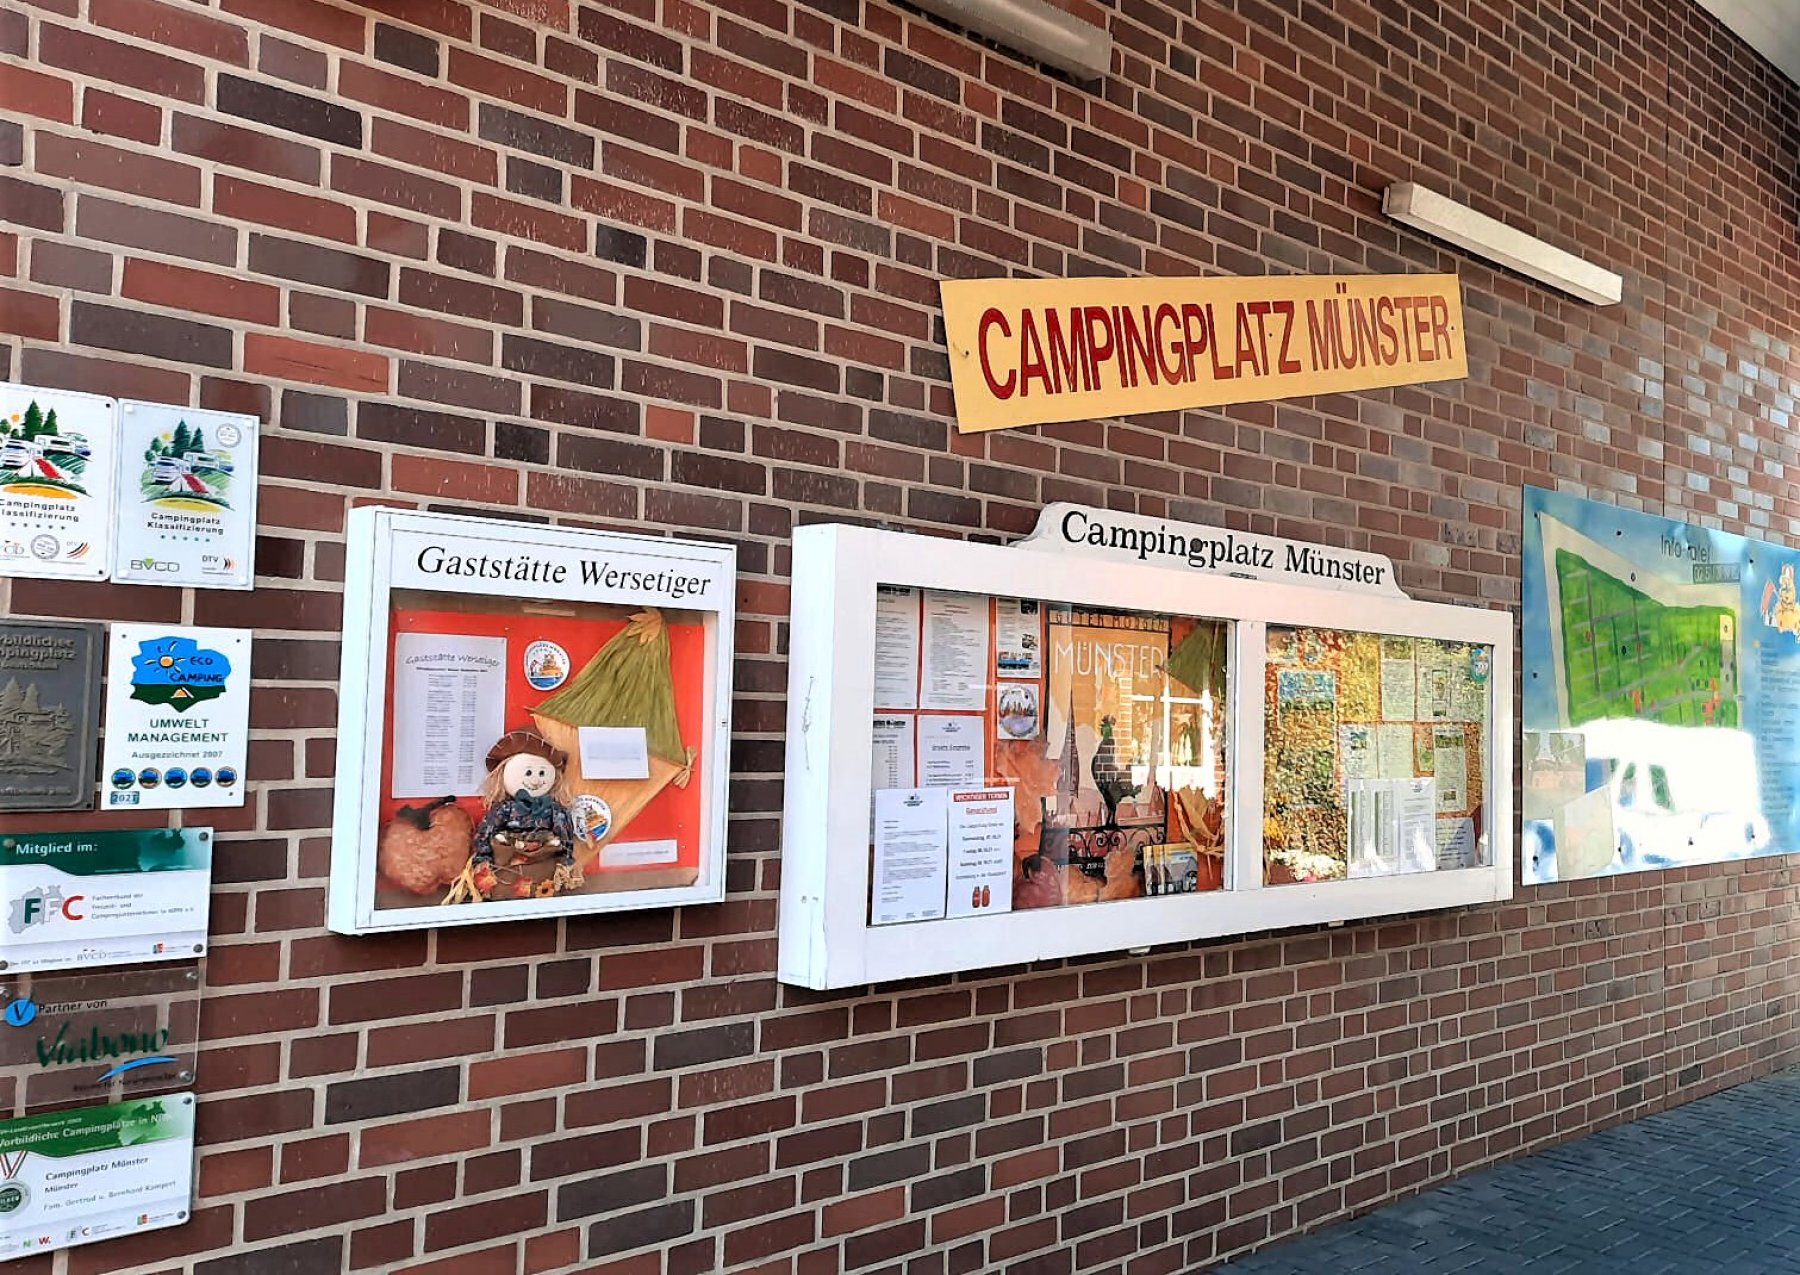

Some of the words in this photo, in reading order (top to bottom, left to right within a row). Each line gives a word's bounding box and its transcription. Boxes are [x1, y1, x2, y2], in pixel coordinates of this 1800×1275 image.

[978, 300, 1301, 400] CAMPINGPLATZ
[1306, 282, 1452, 371] MÜNSTER
[1, 509, 80, 522] lassifizierung
[150, 512, 221, 526] Campingplatz
[146, 521, 225, 535] Klassifizierung
[1061, 511, 1274, 568] Campingplatz
[1284, 545, 1385, 584] Münster
[416, 546, 567, 584] Gaststätte
[580, 560, 711, 599] Wersetiger
[190, 656, 213, 666] ECO
[1055, 641, 1165, 679] MÜNSTER
[170, 673, 223, 682] CAMPING
[150, 718, 209, 729] UMWELT
[128, 732, 229, 743] MANAGEMENT
[131, 751, 200, 760] Ausgezeichnet
[202, 750, 223, 759] 2007
[16, 842, 72, 858] Mitglied
[77, 843, 98, 853] im:
[39, 1003, 81, 1014] Partner
[86, 1000, 107, 1010] von
[63, 1119, 135, 1137] Campingplätze
[46, 1164, 108, 1181] Campingplatz
[111, 1157, 149, 1169] Münster
[44, 1182, 78, 1193] Münster
[43, 1202, 63, 1211] Fam.
